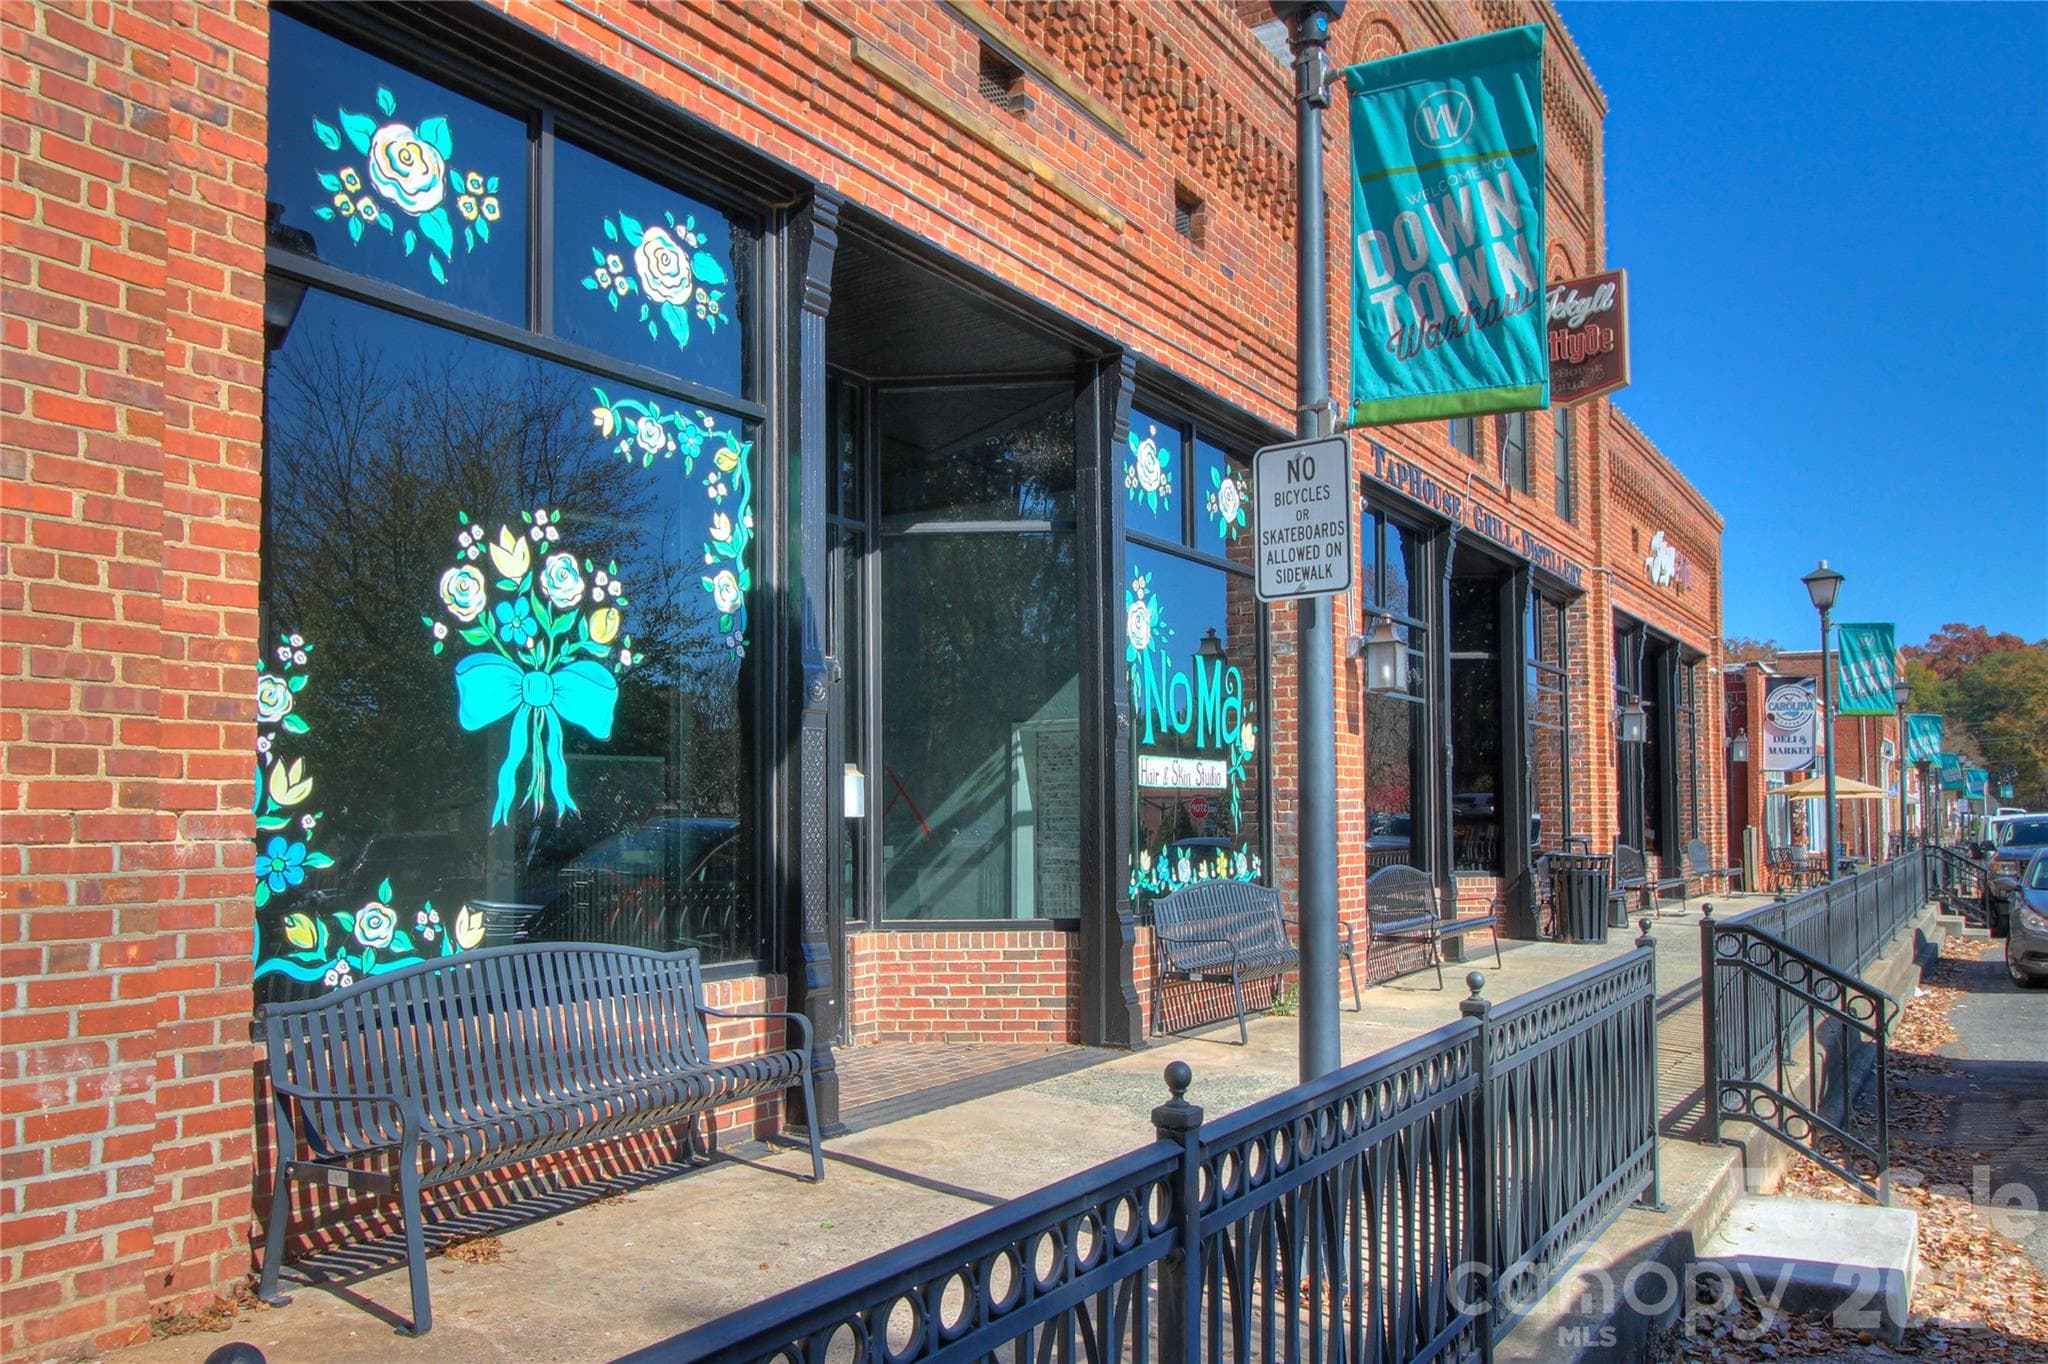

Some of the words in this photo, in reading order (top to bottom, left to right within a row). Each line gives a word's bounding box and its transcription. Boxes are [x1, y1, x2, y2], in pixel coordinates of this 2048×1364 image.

[1406, 167, 1482, 205] WELCOME
[1483, 157, 1506, 172] TO
[1357, 171, 1523, 290] DOWN
[1370, 234, 1539, 346] TOWN
[1546, 282, 1616, 328] Jekyll
[1386, 287, 1537, 363] Waxhaw
[1549, 323, 1614, 364] Hyde
[1287, 456, 1316, 484] NO
[1274, 484, 1331, 507] BICYCLES
[1296, 508, 1310, 522] OR
[1473, 504, 1515, 549] GRILL
[1262, 521, 1345, 546] SKATEBOARDS
[1266, 544, 1320, 566] ALLOWED
[1326, 542, 1343, 558] ON
[1275, 563, 1333, 585] SIDEWALK
[1768, 701, 1814, 712] CAROLINA
[1768, 747, 1812, 755] MARKET
[1773, 735, 1797, 744] DELI
[1141, 758, 1159, 785] Hair
[1195, 762, 1222, 787] Studio
